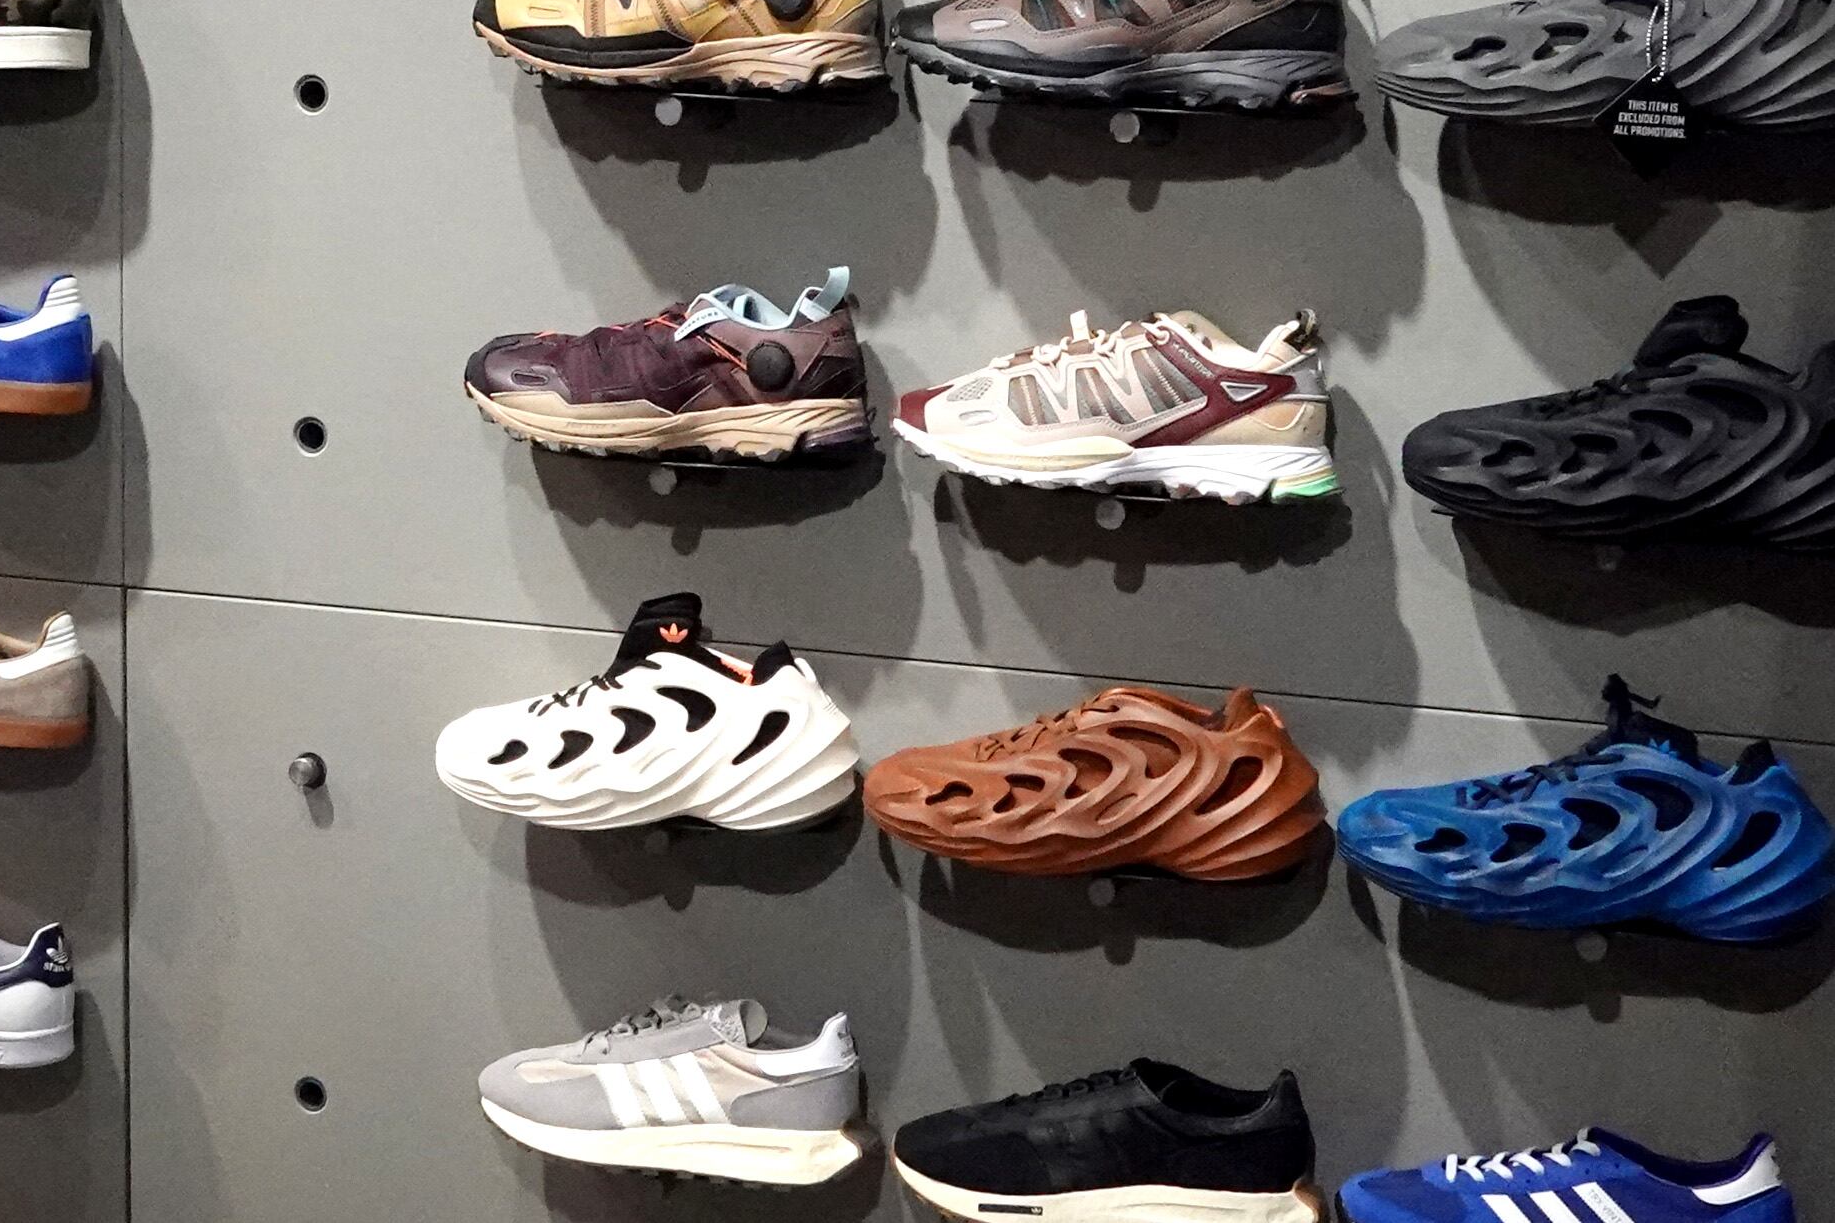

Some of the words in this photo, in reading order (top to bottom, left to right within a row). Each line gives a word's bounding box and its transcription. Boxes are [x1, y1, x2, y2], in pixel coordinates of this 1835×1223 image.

[1628, 99, 1647, 111] THIS
[1648, 101, 1669, 112] ITEM
[1670, 102, 1679, 113] IS
[1618, 112, 1660, 124] EXCLUDED
[1662, 114, 1685, 125] FROM
[1613, 125, 1628, 135] ALL
